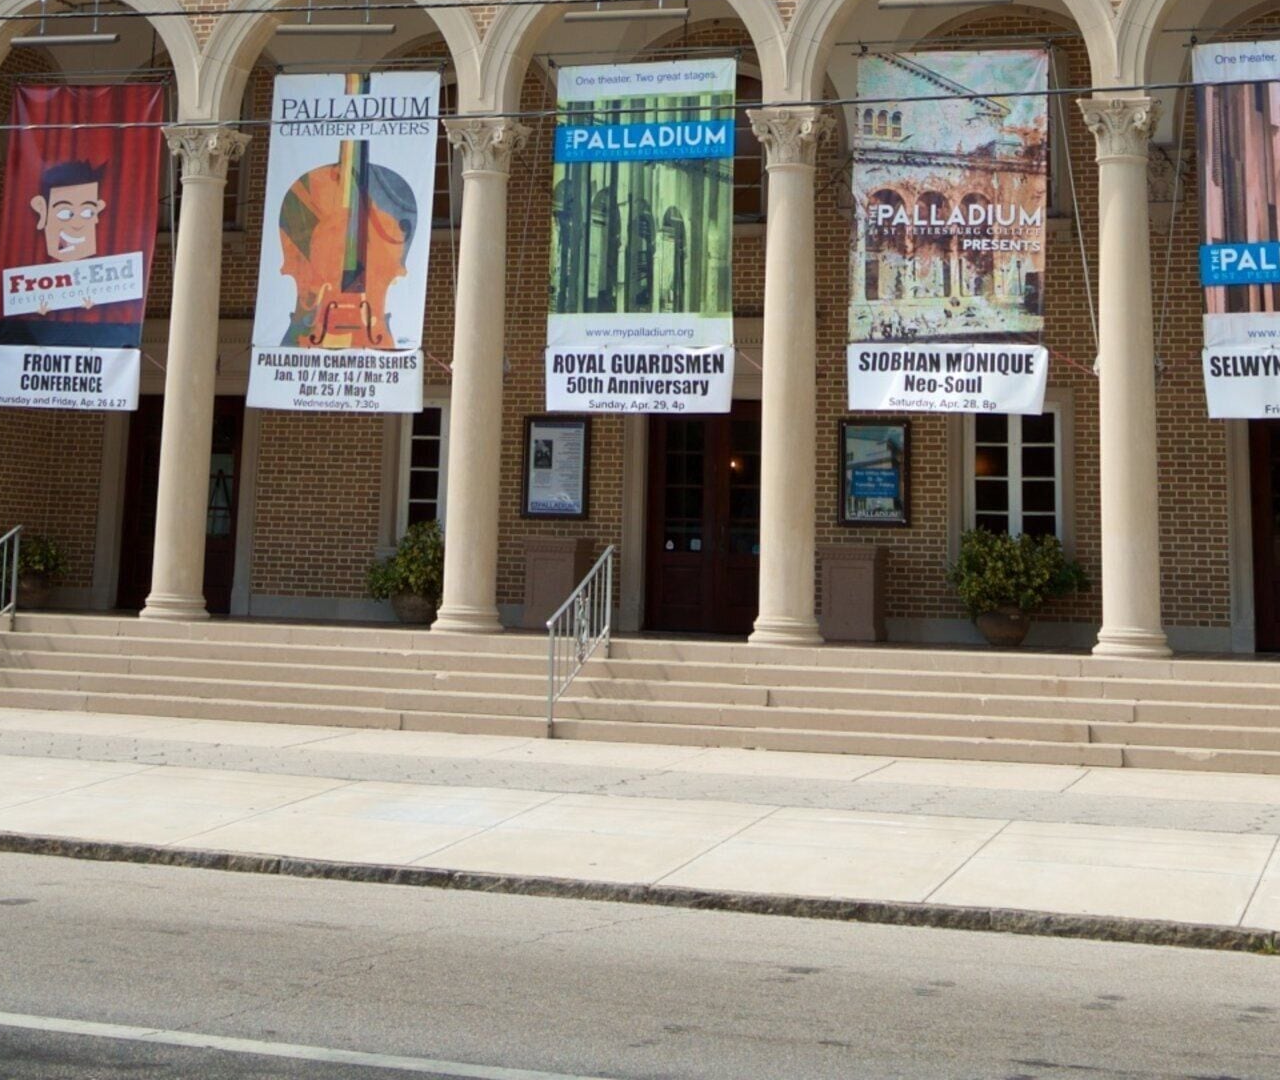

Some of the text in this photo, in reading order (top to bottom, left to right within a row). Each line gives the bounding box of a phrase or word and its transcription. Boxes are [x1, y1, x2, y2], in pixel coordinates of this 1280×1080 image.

[1214, 53, 1236, 64] One
[1239, 53, 1277, 63] theater.
[575, 71, 718, 86] One theater. Two great stages.
[281, 97, 431, 120] PALLADIUM
[279, 122, 430, 137] CHAMBER PLAYERS
[573, 125, 726, 150] PALLADIUM
[878, 204, 1041, 226] PALLADIUM
[963, 239, 1041, 252] PRESENTS
[1210, 249, 1219, 272] THE
[9, 260, 133, 293] Front-End
[10, 283, 136, 306] design conference
[585, 327, 694, 339] www.mypalladium.org
[23, 354, 102, 374] FRONT END
[257, 353, 417, 369] PALLADIUM CHAMBER SERIES
[553, 353, 725, 374] ROYAL GUARDSMEN
[858, 351, 1034, 375] SIOBHAN MONIQUE
[21, 374, 102, 393] CONFERENCE
[274, 370, 295, 382] Jan.
[298, 371, 309, 382] 10
[319, 371, 340, 382] Mar.
[343, 371, 354, 383] 14
[364, 372, 384, 383] Mar.
[386, 372, 399, 384] 28
[566, 376, 709, 396] 50th Anniversary
[904, 375, 982, 393] Neo-Soul
[299, 384, 319, 397] Apr.
[321, 384, 334, 396] 25
[344, 385, 367, 399] May
[368, 385, 376, 397] 9
[33, 397, 49, 405] and
[81, 399, 95, 408] Apr.
[98, 398, 107, 407] 26
[116, 399, 126, 408] 27
[588, 400, 628, 410] Sunday,
[631, 400, 650, 410] Apr.
[671, 400, 685, 411] 4p
[940, 399, 960, 409] Apr.
[982, 399, 997, 411] 8p
